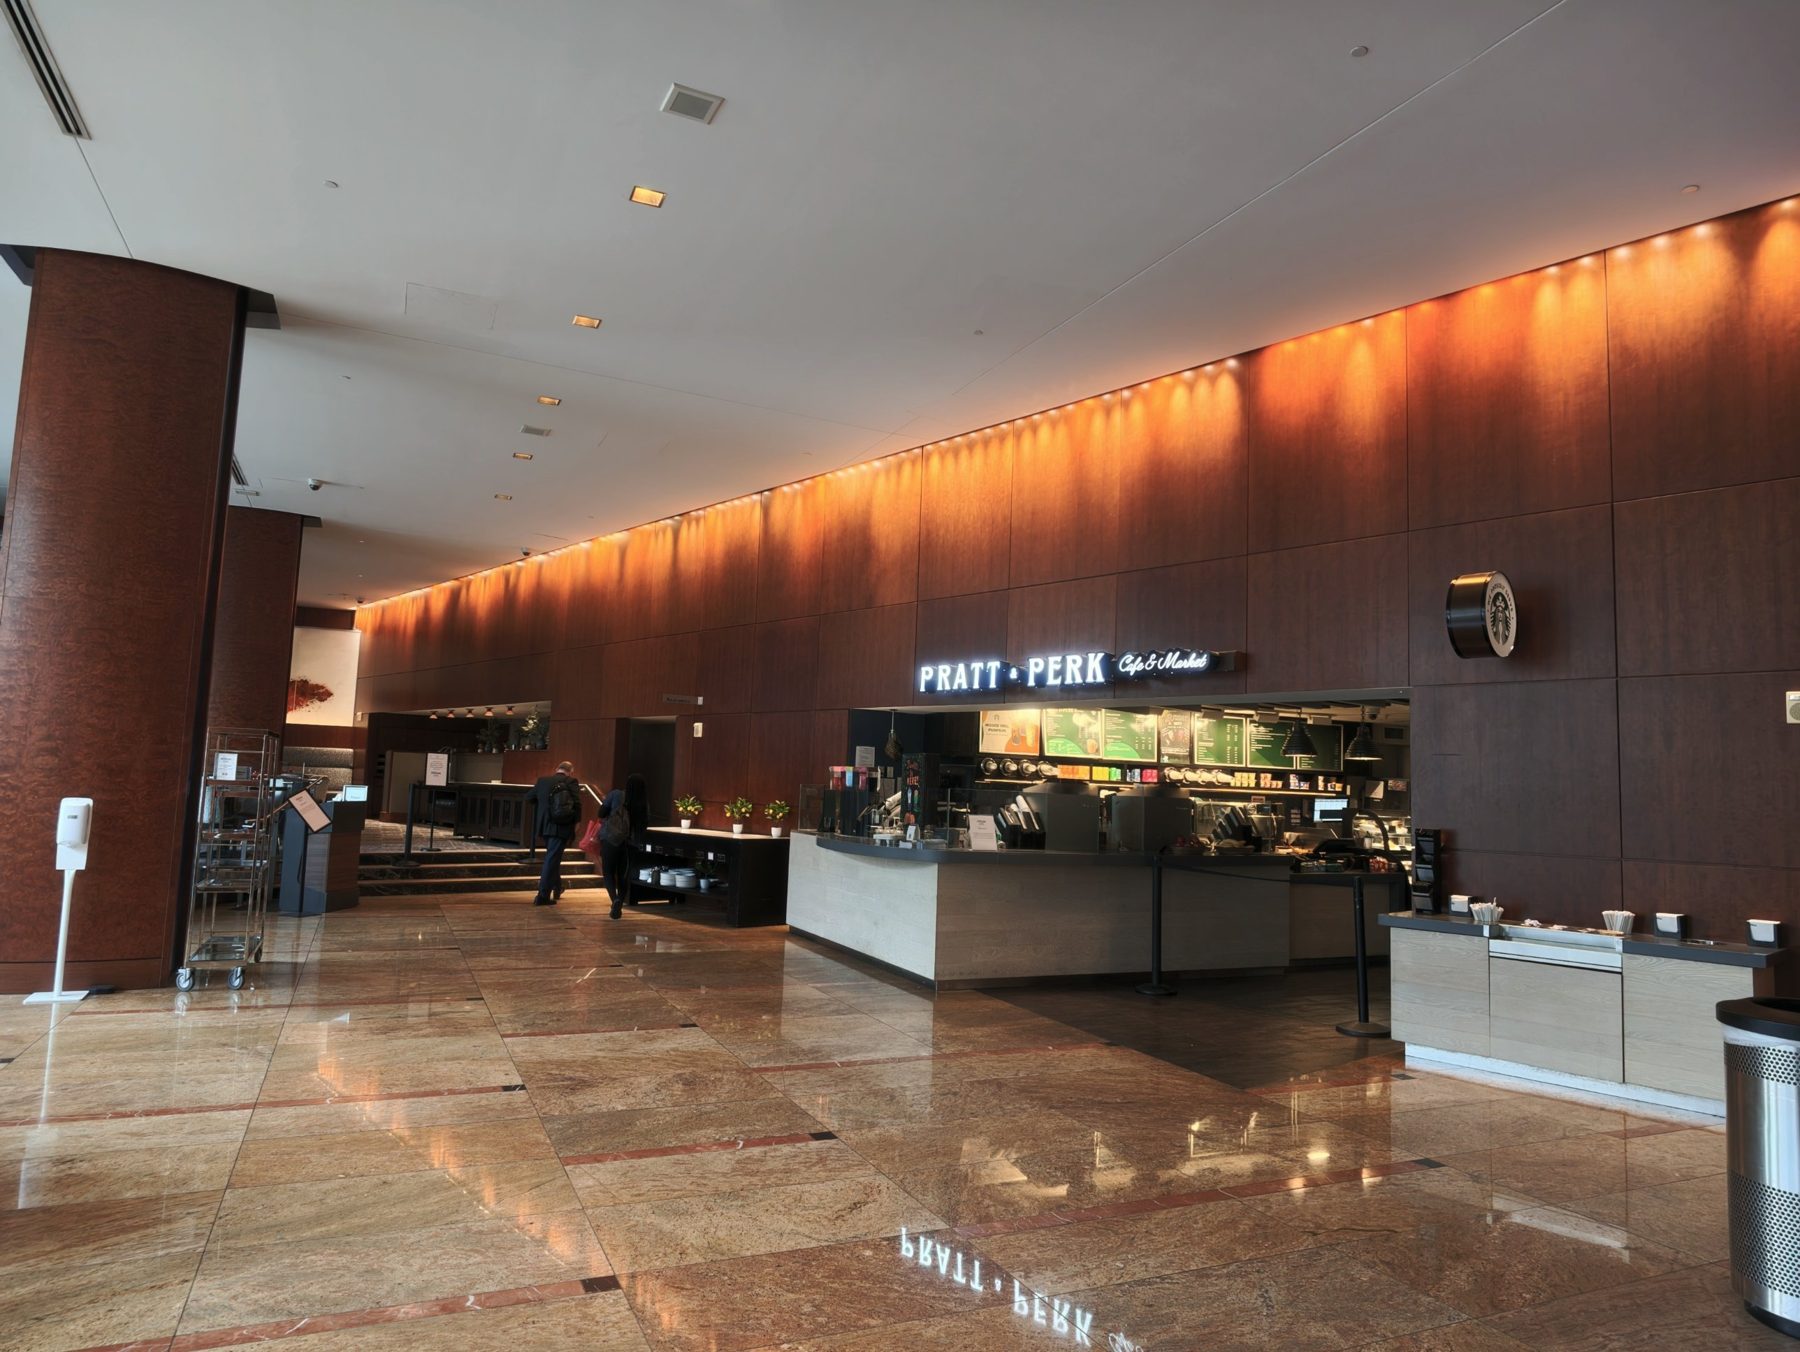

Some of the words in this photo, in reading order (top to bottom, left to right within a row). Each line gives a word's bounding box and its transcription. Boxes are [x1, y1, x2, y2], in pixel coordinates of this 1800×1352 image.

[920, 660, 1001, 692] PRATT
[1009, 666, 1018, 679] &
[1027, 652, 1105, 687] PERK
[1145, 653, 1158, 670] &
[1157, 651, 1208, 670] Market
